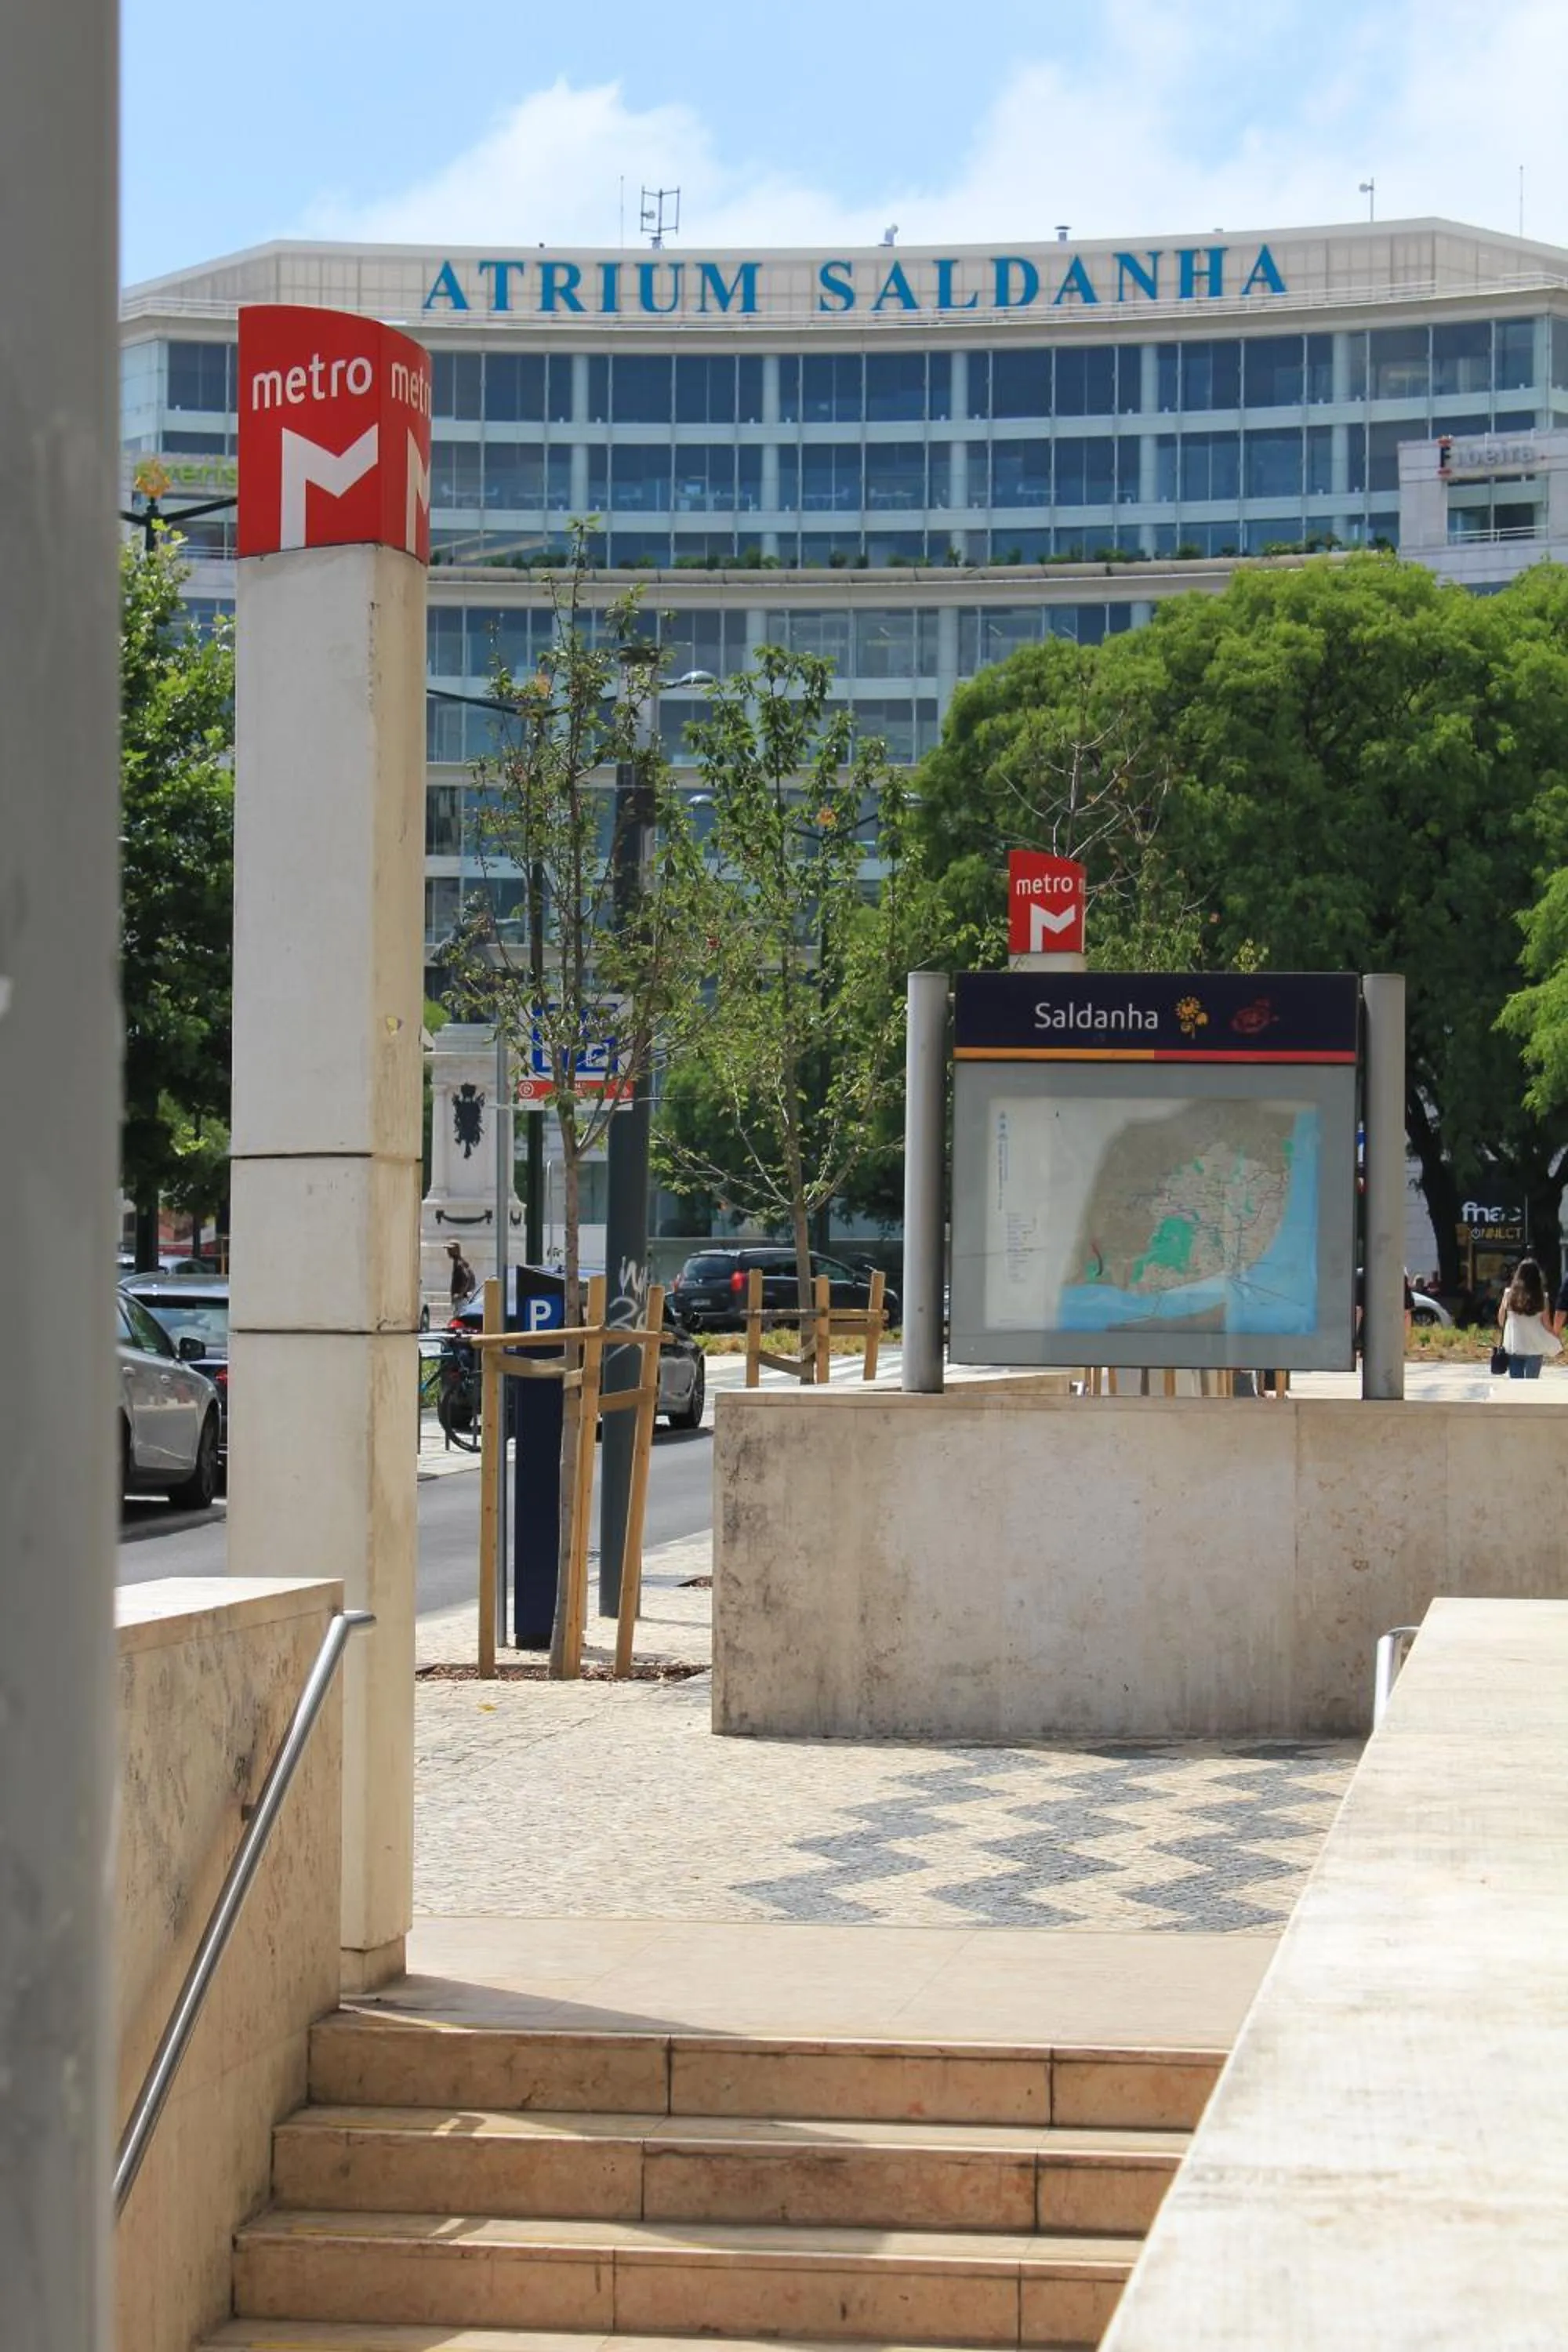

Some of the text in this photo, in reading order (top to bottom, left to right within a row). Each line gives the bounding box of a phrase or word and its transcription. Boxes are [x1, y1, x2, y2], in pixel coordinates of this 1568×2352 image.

[423, 244, 1288, 313] ATRIUM SALDANHA
[252, 353, 373, 411] metro
[391, 361, 433, 420] metr
[1016, 875, 1073, 895] metro
[1034, 1003, 1159, 1029] Saldanha
[1461, 1201, 1523, 1223] fnac
[529, 1299, 552, 1331] P
